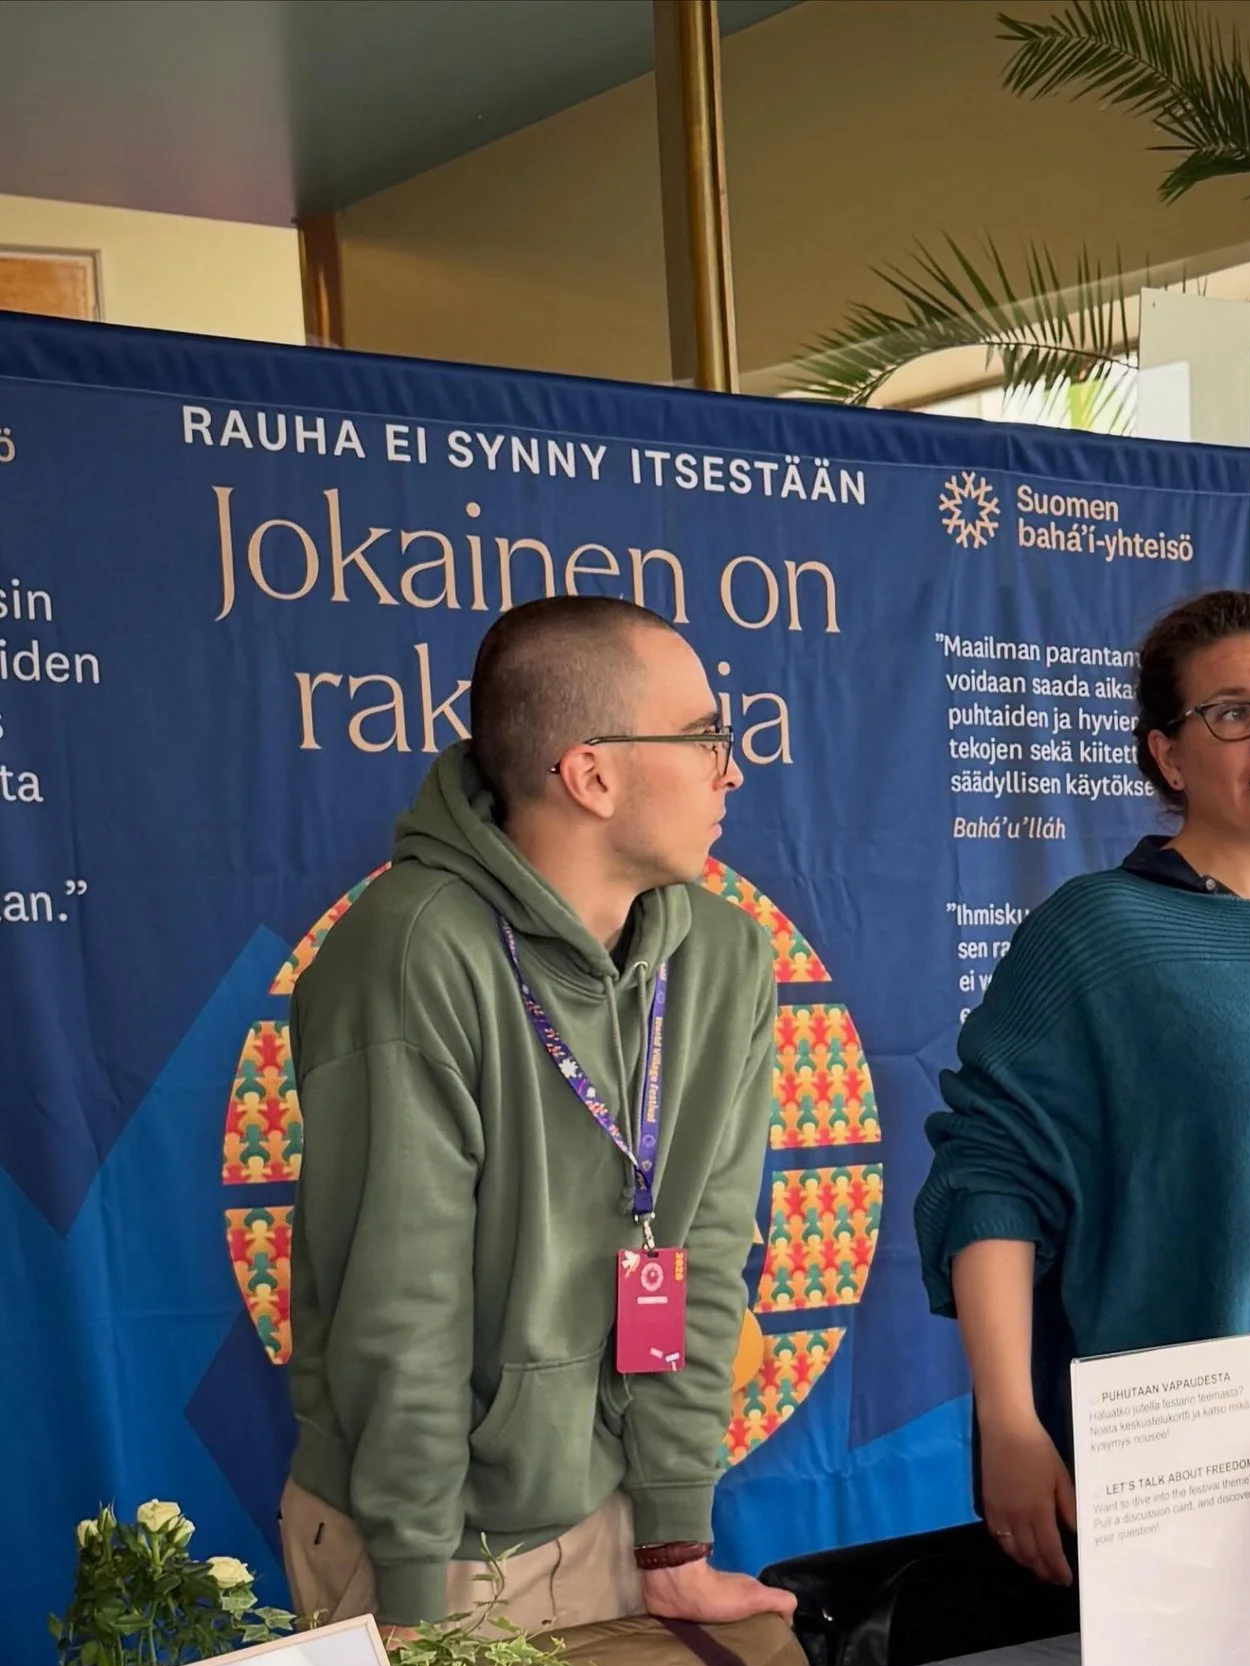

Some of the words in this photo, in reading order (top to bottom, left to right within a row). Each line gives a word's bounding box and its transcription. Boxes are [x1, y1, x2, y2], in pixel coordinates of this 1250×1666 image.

[182, 404, 365, 458] RAUHA
[385, 423, 427, 464] EI
[448, 430, 607, 480] SYNNY
[631, 448, 865, 506] ITSESTÄÄN
[1017, 484, 1119, 522] Suomen
[1018, 518, 1194, 562] bahá’í-yhteisö
[211, 486, 690, 622] Jokainen
[720, 555, 841, 633] on
[935, 632, 1041, 661] ”Maailman
[946, 669, 1026, 693] voidaan
[1032, 675, 1090, 697] saada
[1095, 677, 1137, 699] aika
[949, 702, 1048, 729] puhtaiden
[1053, 707, 1072, 734] ja
[949, 736, 1022, 764] tekojen
[1030, 739, 1073, 762] sekä
[1080, 740, 1139, 764] kiitett
[951, 771, 1061, 798] säädyllisen
[1066, 773, 1154, 801] käytökse
[953, 816, 1066, 839] Bahá’u’lláh
[0, 879, 88, 922] an.”
[946, 902, 1030, 926] ”Ihmisku
[957, 941, 987, 959] sen
[959, 969, 975, 992] ei
[1102, 1384, 1159, 1402] PUHUTAAN
[1162, 1372, 1231, 1393] VAPAUDESTA
[1106, 1480, 1136, 1495] LET'S
[1139, 1472, 1165, 1488] TALK
[1168, 1466, 1202, 1484] ABOUT
